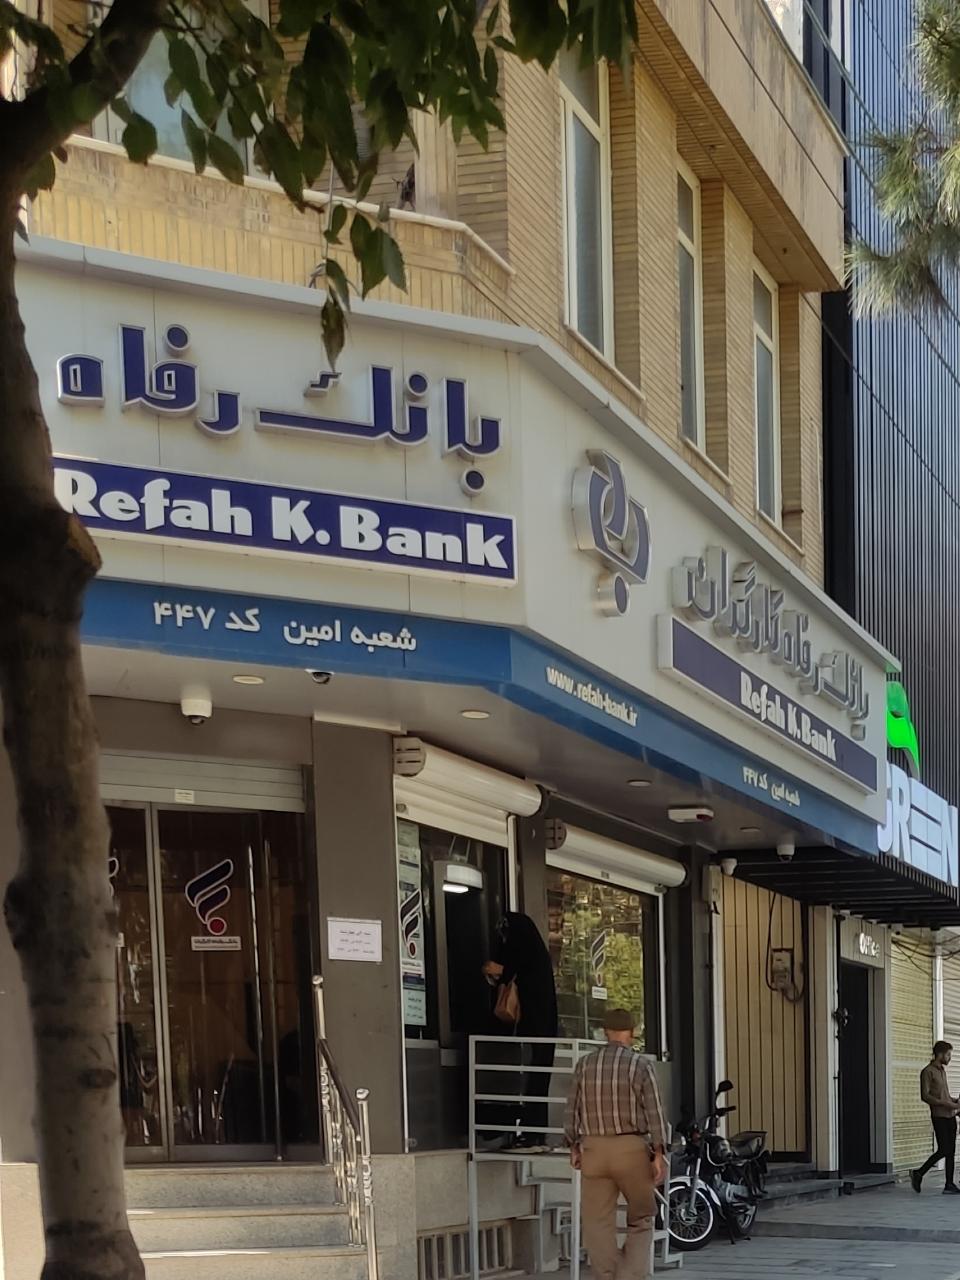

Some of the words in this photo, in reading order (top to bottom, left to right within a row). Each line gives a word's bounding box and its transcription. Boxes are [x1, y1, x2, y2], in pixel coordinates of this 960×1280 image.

[56, 323, 241, 437] رفاه
[255, 363, 501, 497] بانک
[54, 468, 253, 537] Refah
[153, 601, 216, 631] ۴۴۷
[224, 607, 261, 633] کد
[282, 618, 342, 646] امین
[351, 626, 417, 654] شعبه
[784, 610, 821, 694] رفاه
[546, 666, 638, 728] www.refah-bank.ir
[740, 671, 786, 731] Refah
[819, 649, 870, 741] بانک
